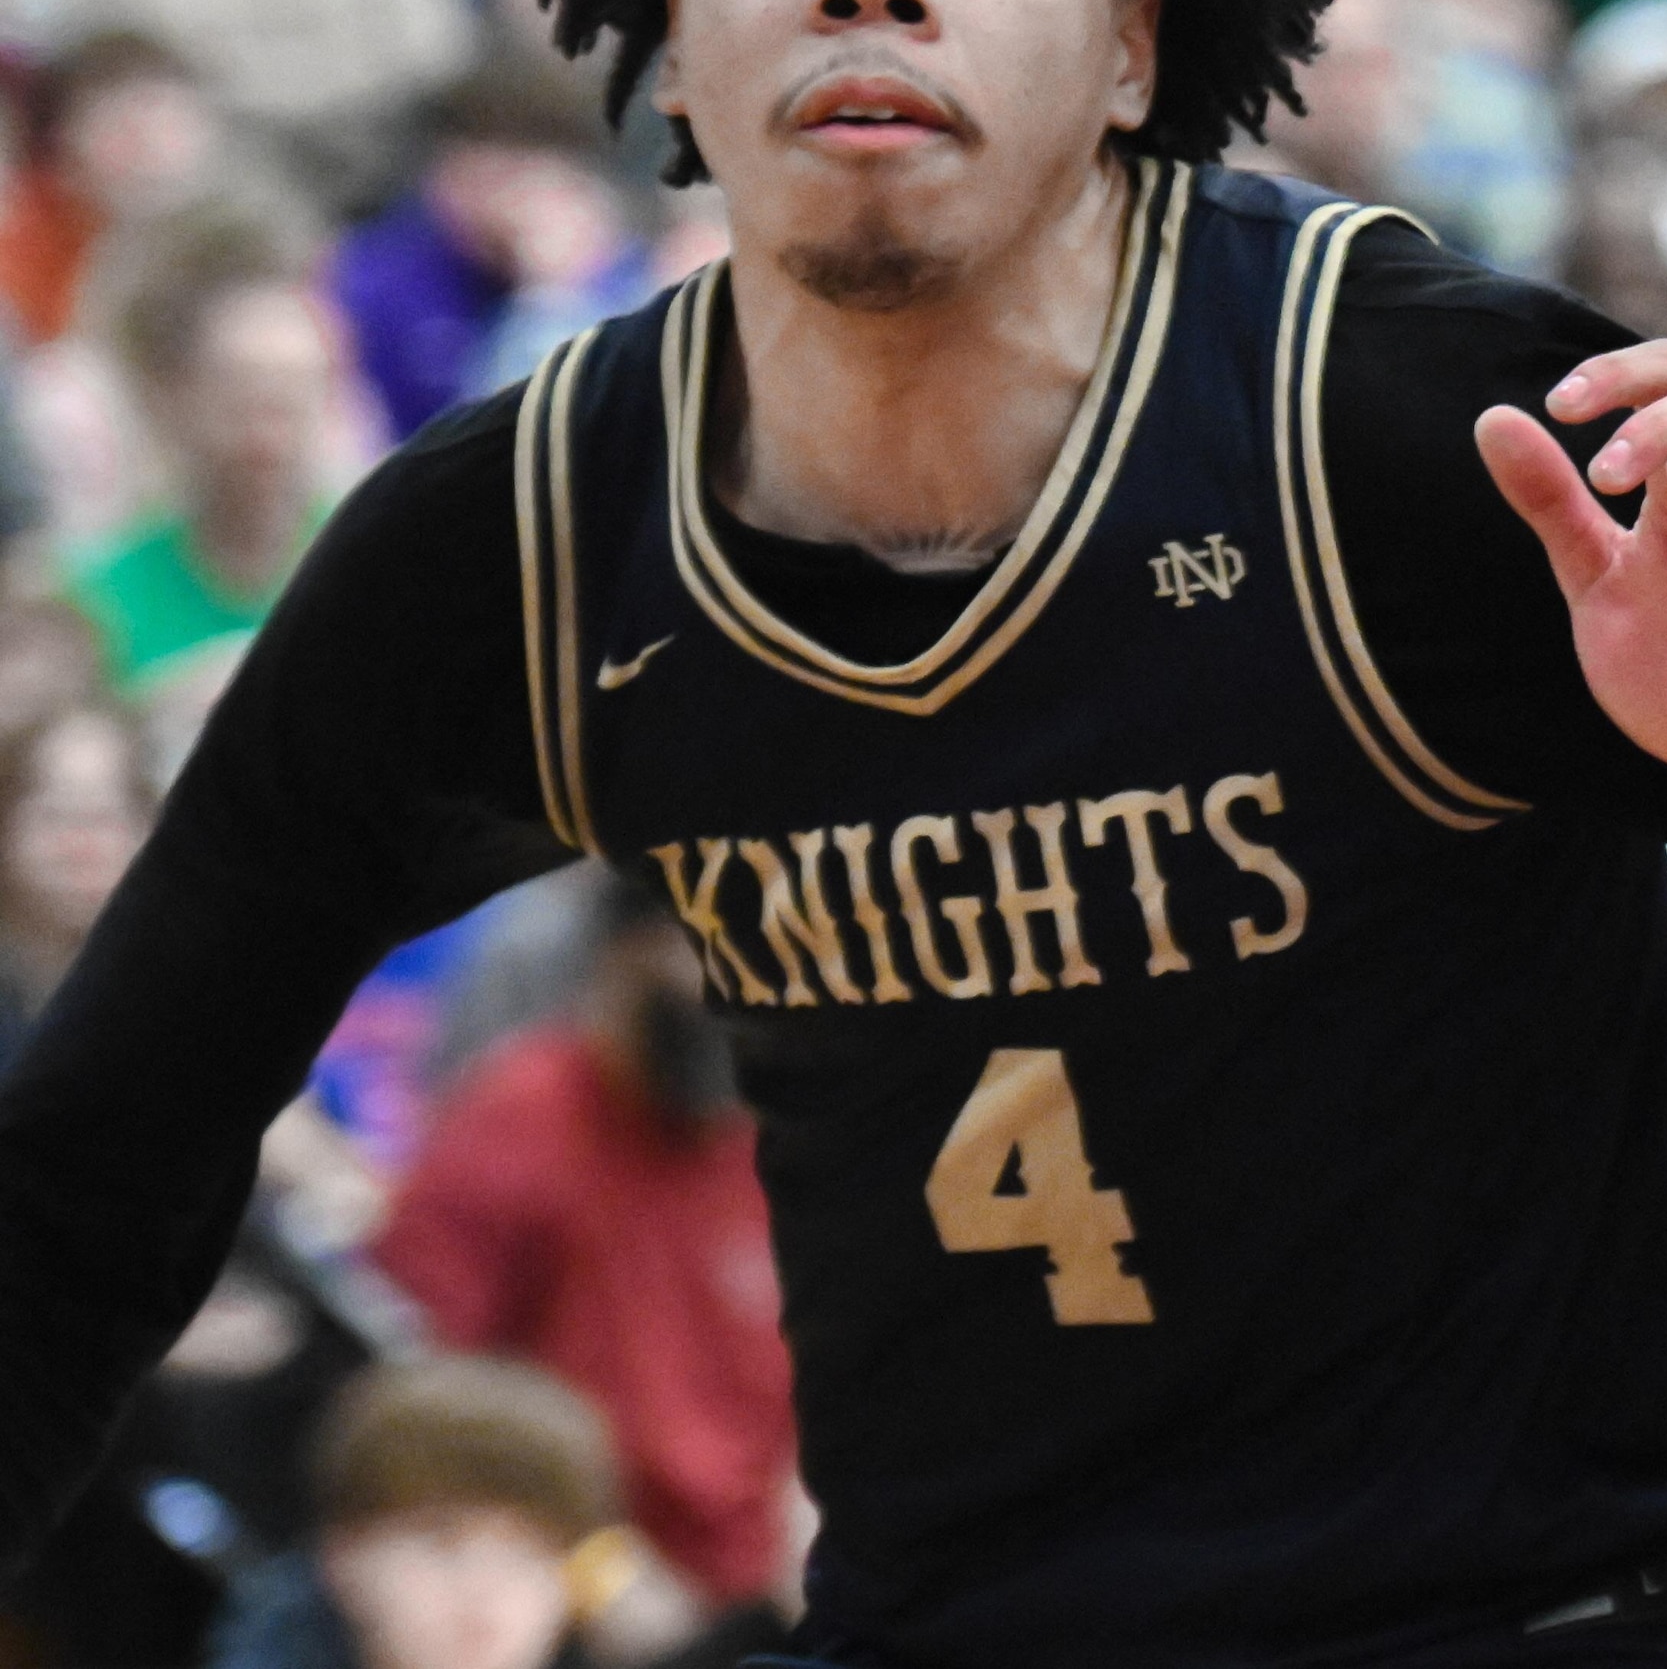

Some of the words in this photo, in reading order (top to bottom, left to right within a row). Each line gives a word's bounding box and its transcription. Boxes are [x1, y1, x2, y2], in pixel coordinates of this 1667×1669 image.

[1147, 532, 1246, 608] ND
[648, 771, 1309, 1008] KNIGHTS
[925, 1048, 1154, 1325] 4
